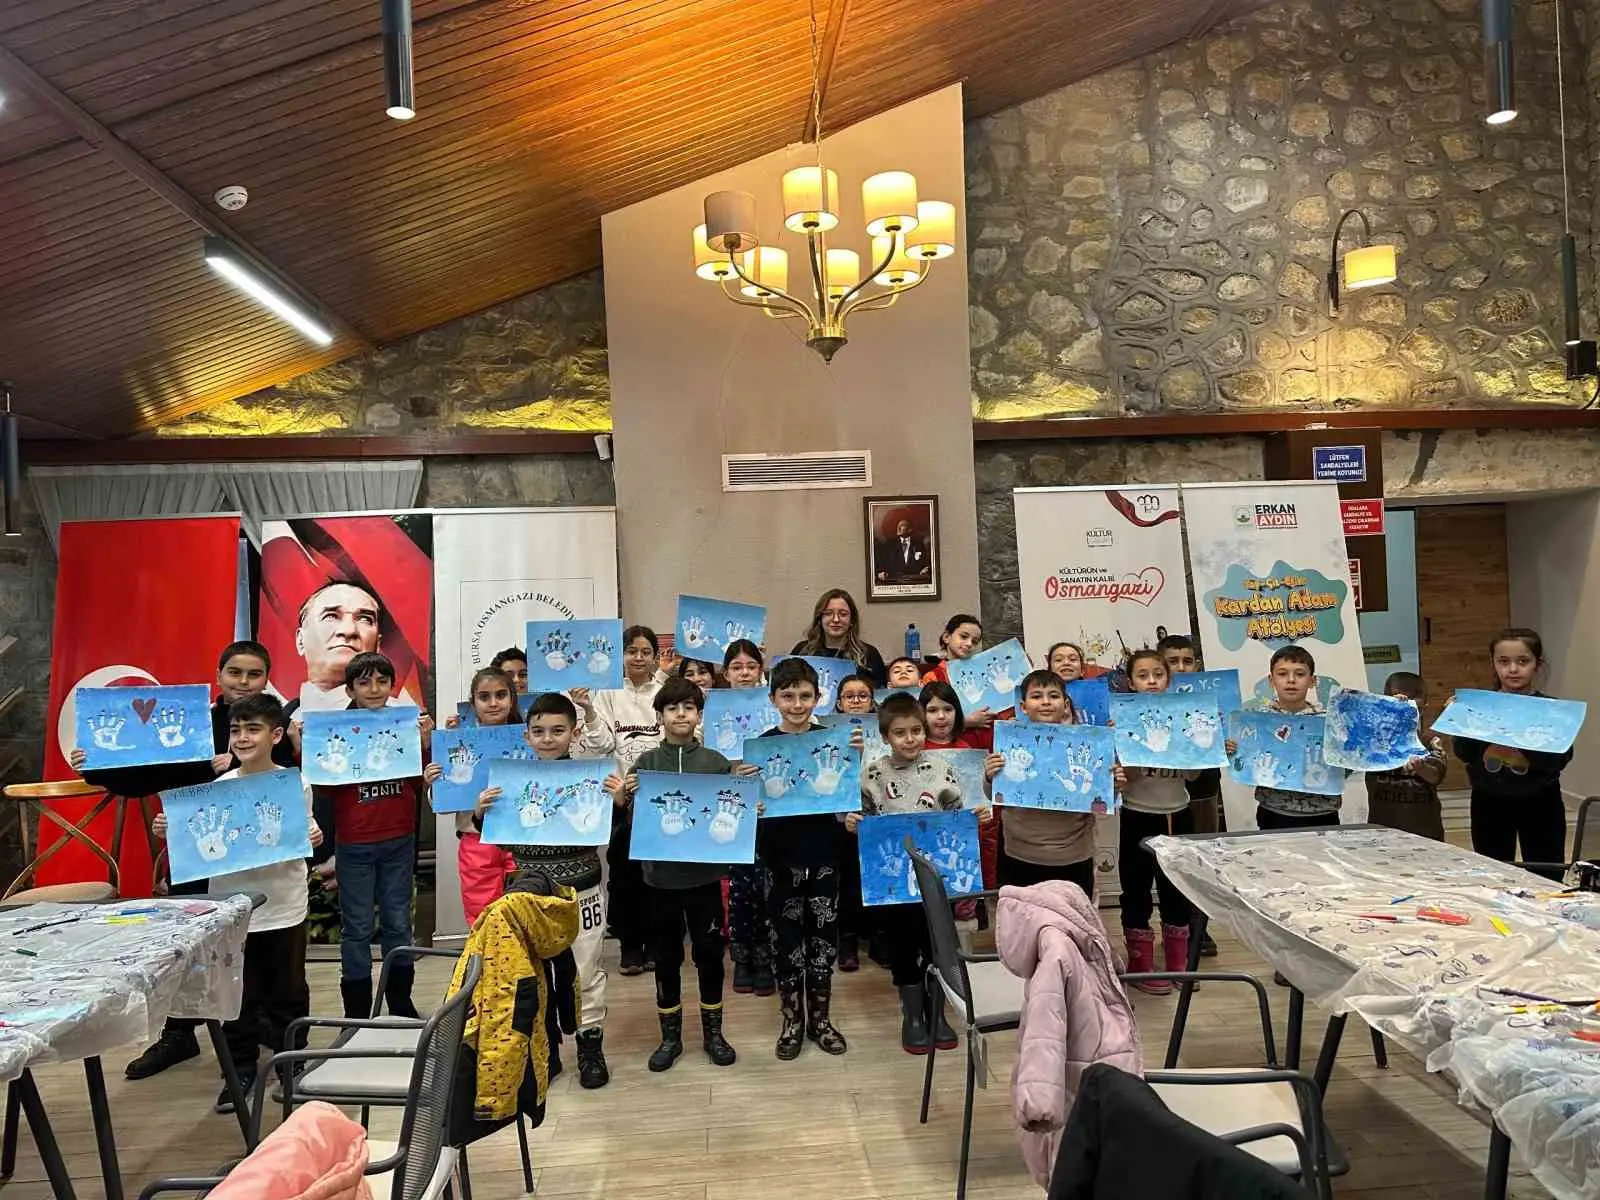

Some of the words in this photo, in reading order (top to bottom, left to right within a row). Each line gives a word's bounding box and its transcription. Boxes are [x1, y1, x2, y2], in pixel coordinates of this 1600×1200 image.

[1255, 503, 1296, 514] ERKAN
[1259, 514, 1296, 525] AYDIN
[1059, 566, 1098, 575] KÜLTÜRÜN
[1059, 576, 1093, 584] SANATIN
[1045, 575, 1153, 603] Osmangazi
[1214, 590, 1284, 617] Kardan
[1287, 588, 1337, 611] Adam
[471, 629, 482, 665] BURSA
[582, 903, 602, 930] 86
